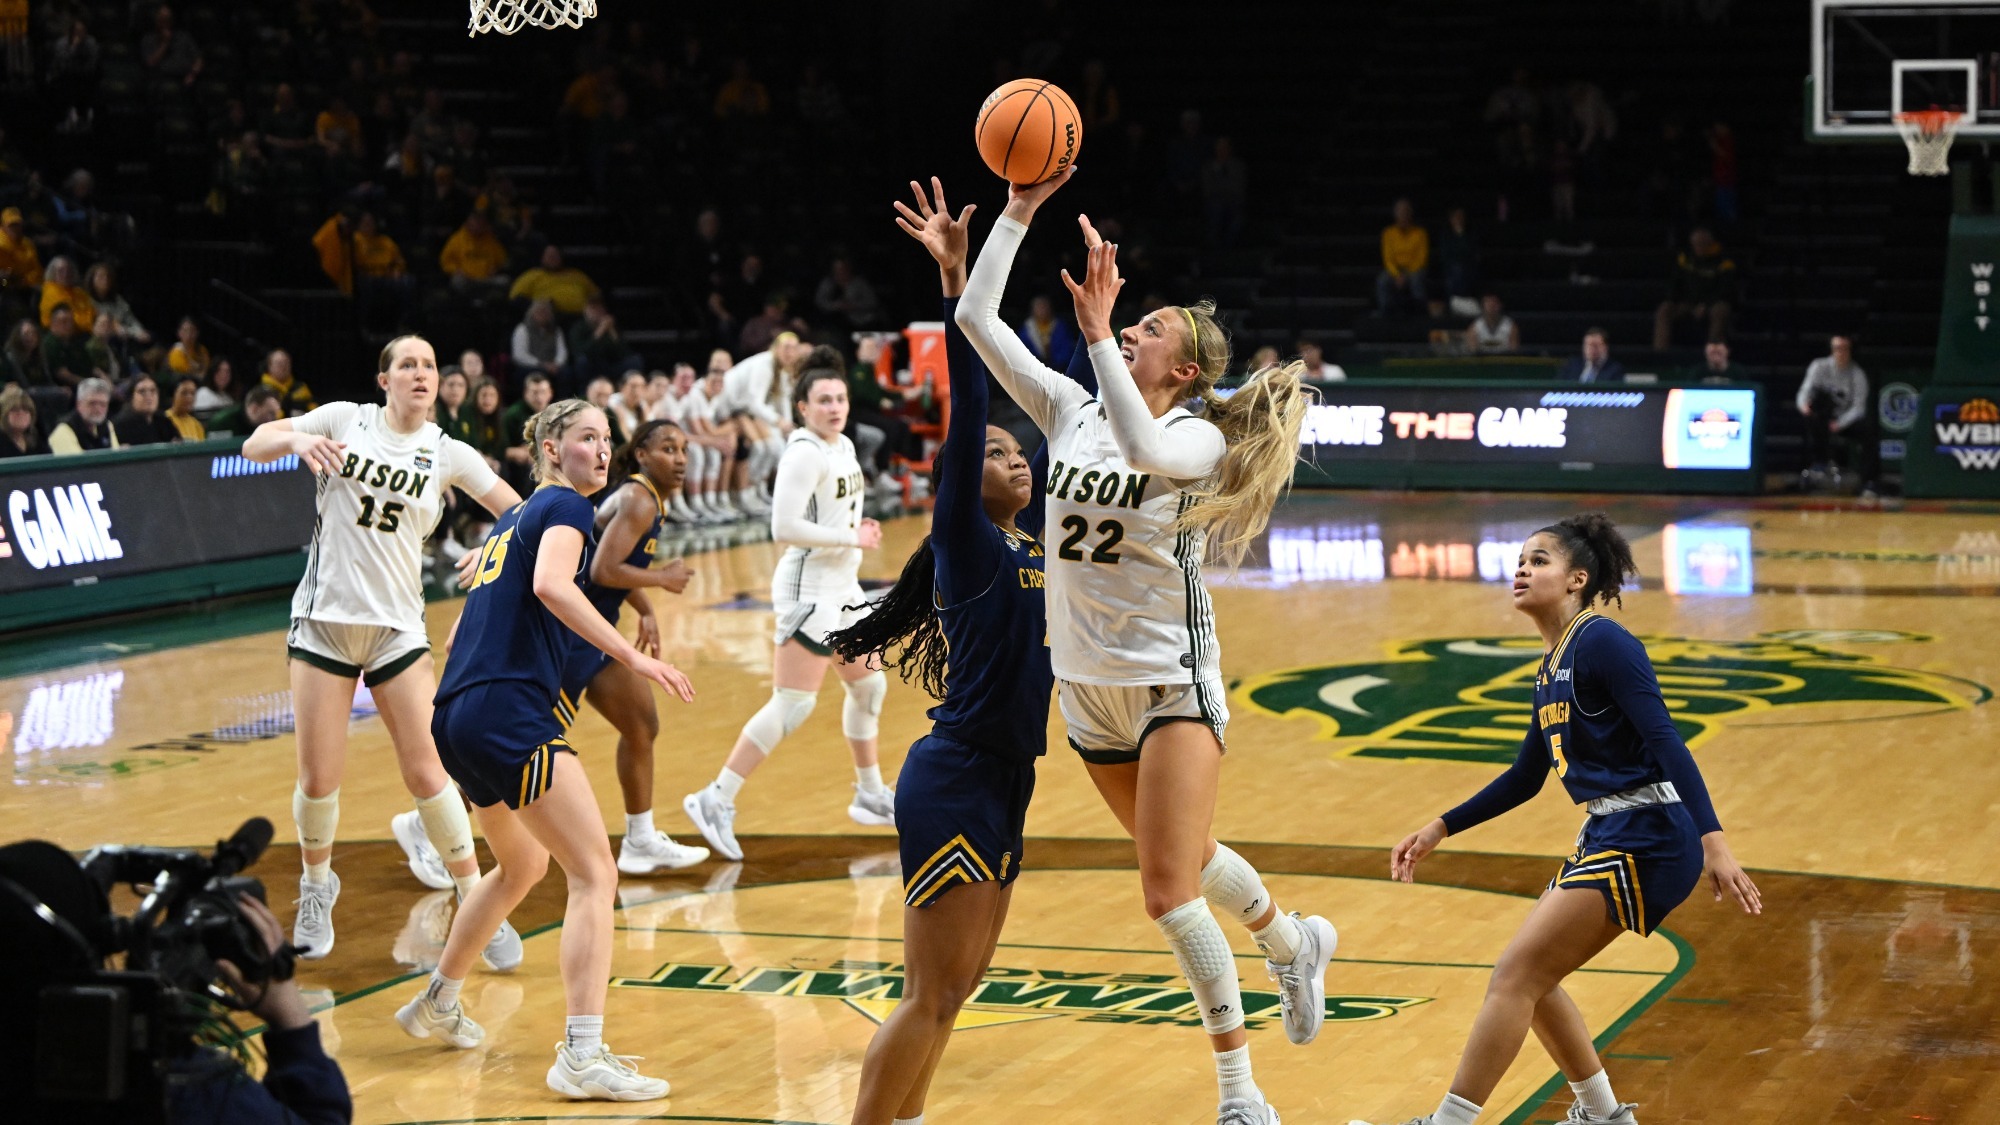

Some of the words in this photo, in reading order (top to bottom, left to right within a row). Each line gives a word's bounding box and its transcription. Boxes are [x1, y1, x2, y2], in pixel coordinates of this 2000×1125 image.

[1389, 411, 1475, 440] THE
[1478, 406, 1567, 448] GAME
[340, 452, 429, 499] BISON
[1046, 459, 1150, 511] BISON
[8, 482, 123, 570] GAME
[356, 494, 404, 533] 15
[470, 525, 515, 592] 15
[1058, 514, 1125, 565] 22
[1550, 733, 1569, 779] 5
